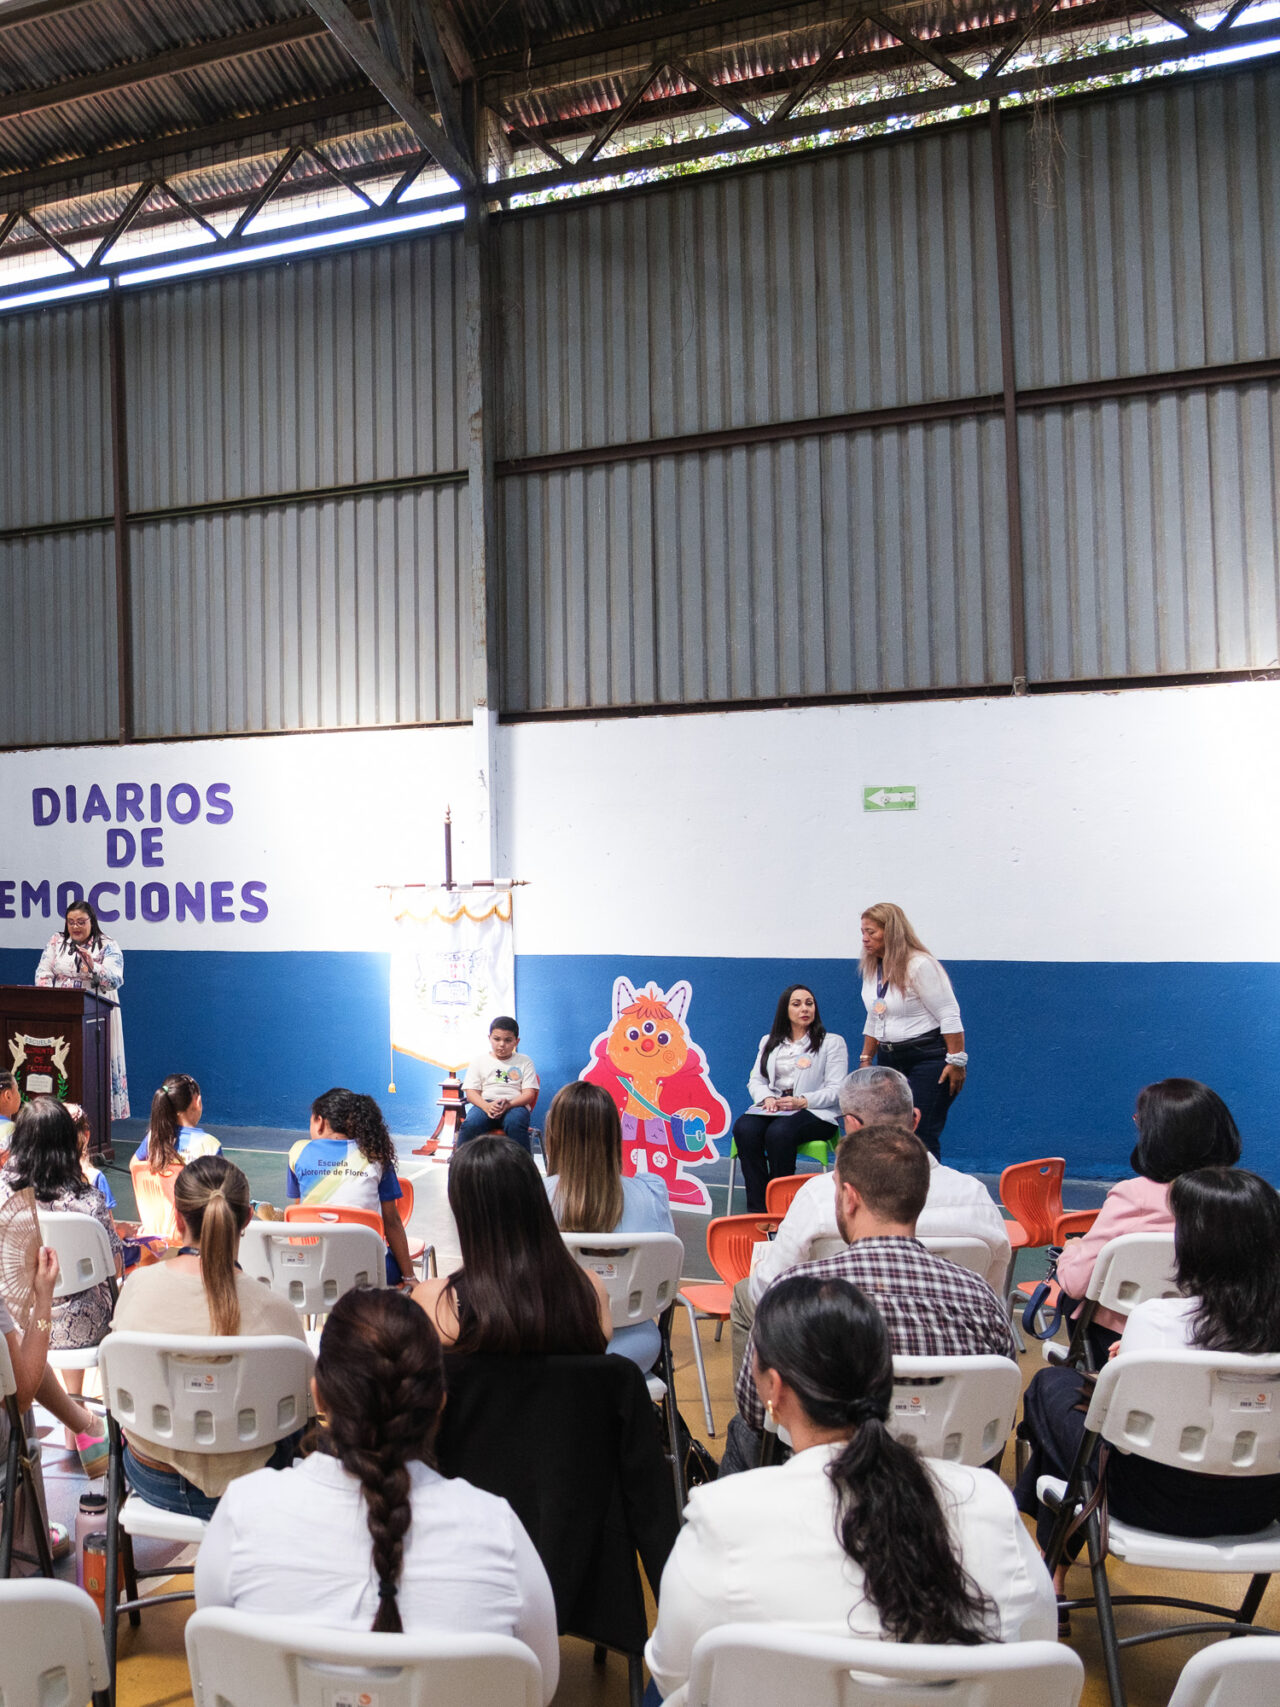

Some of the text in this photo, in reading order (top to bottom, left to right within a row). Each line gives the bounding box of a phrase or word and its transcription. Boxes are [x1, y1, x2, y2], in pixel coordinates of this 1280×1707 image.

[32, 782, 234, 826] DIARIOS
[106, 827, 164, 868] DE
[24, 1036, 52, 1046] ESCUELA
[317, 1159, 349, 1167] Escuela
[333, 1168, 343, 1176] de
[345, 1169, 369, 1178] Flores
